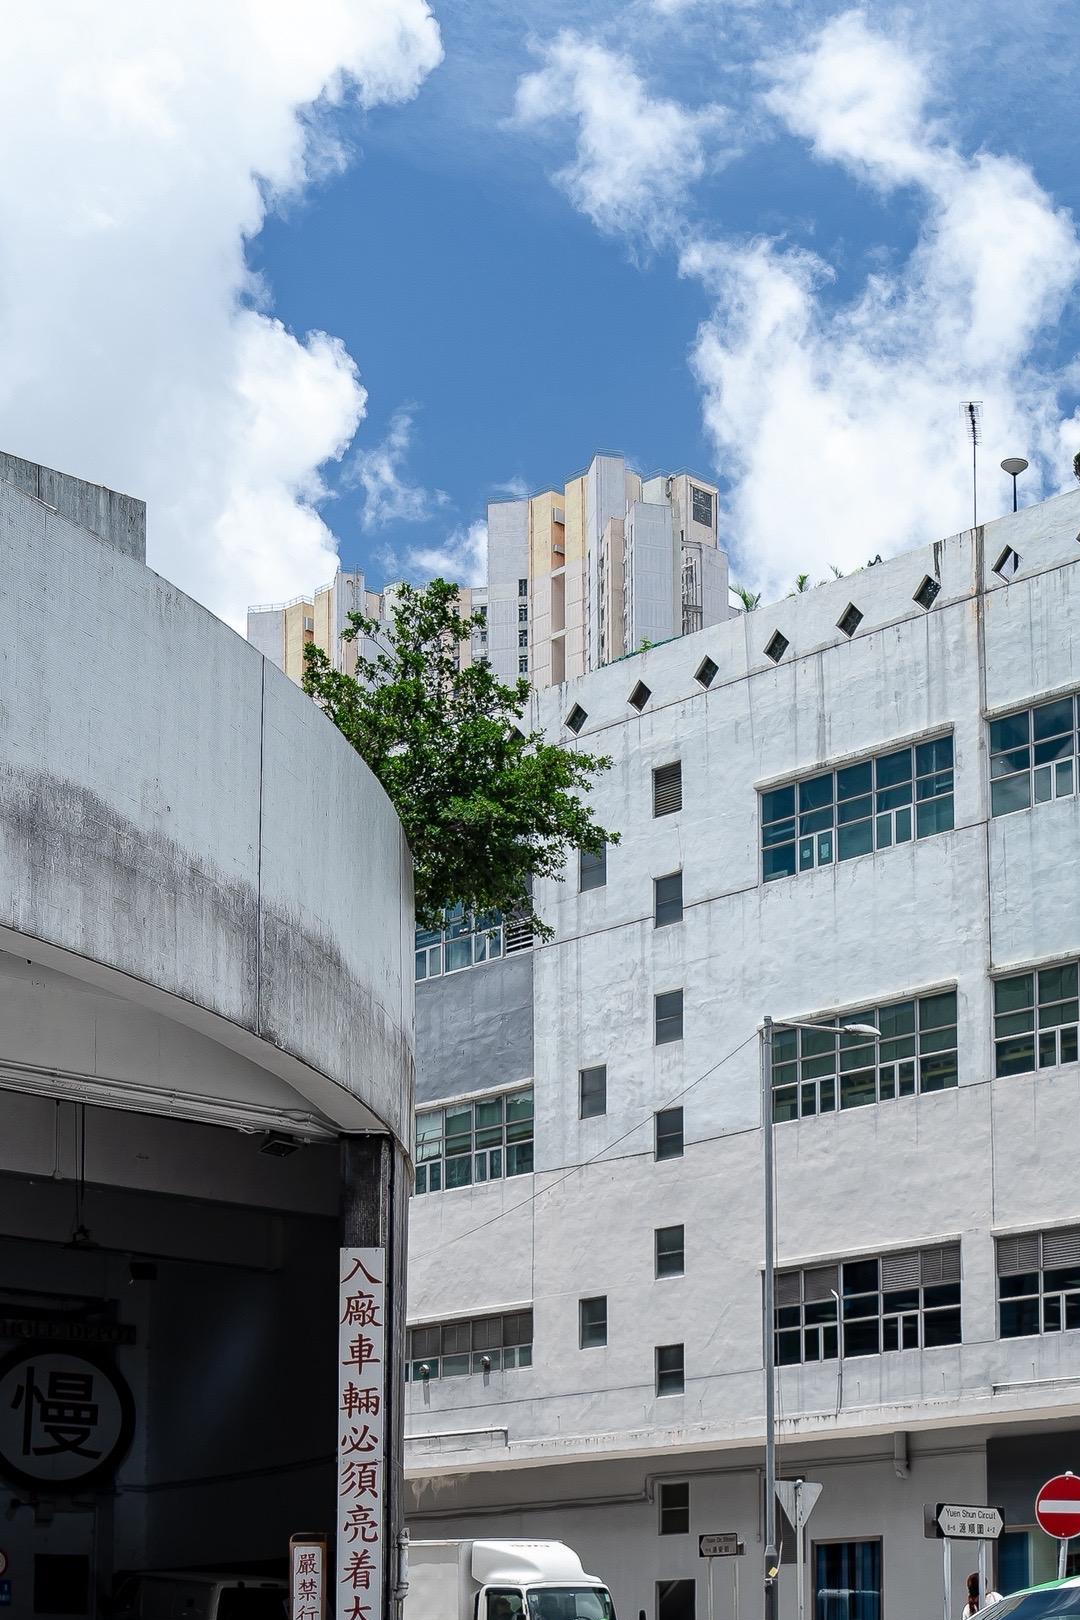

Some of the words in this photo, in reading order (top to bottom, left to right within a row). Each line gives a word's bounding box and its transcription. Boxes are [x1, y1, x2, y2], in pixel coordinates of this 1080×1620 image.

[10, 1366, 102, 1460] 慢
[945, 1508, 960, 1518] Yuen
[961, 1509, 977, 1519] Shun
[977, 1510, 996, 1520] Circuit
